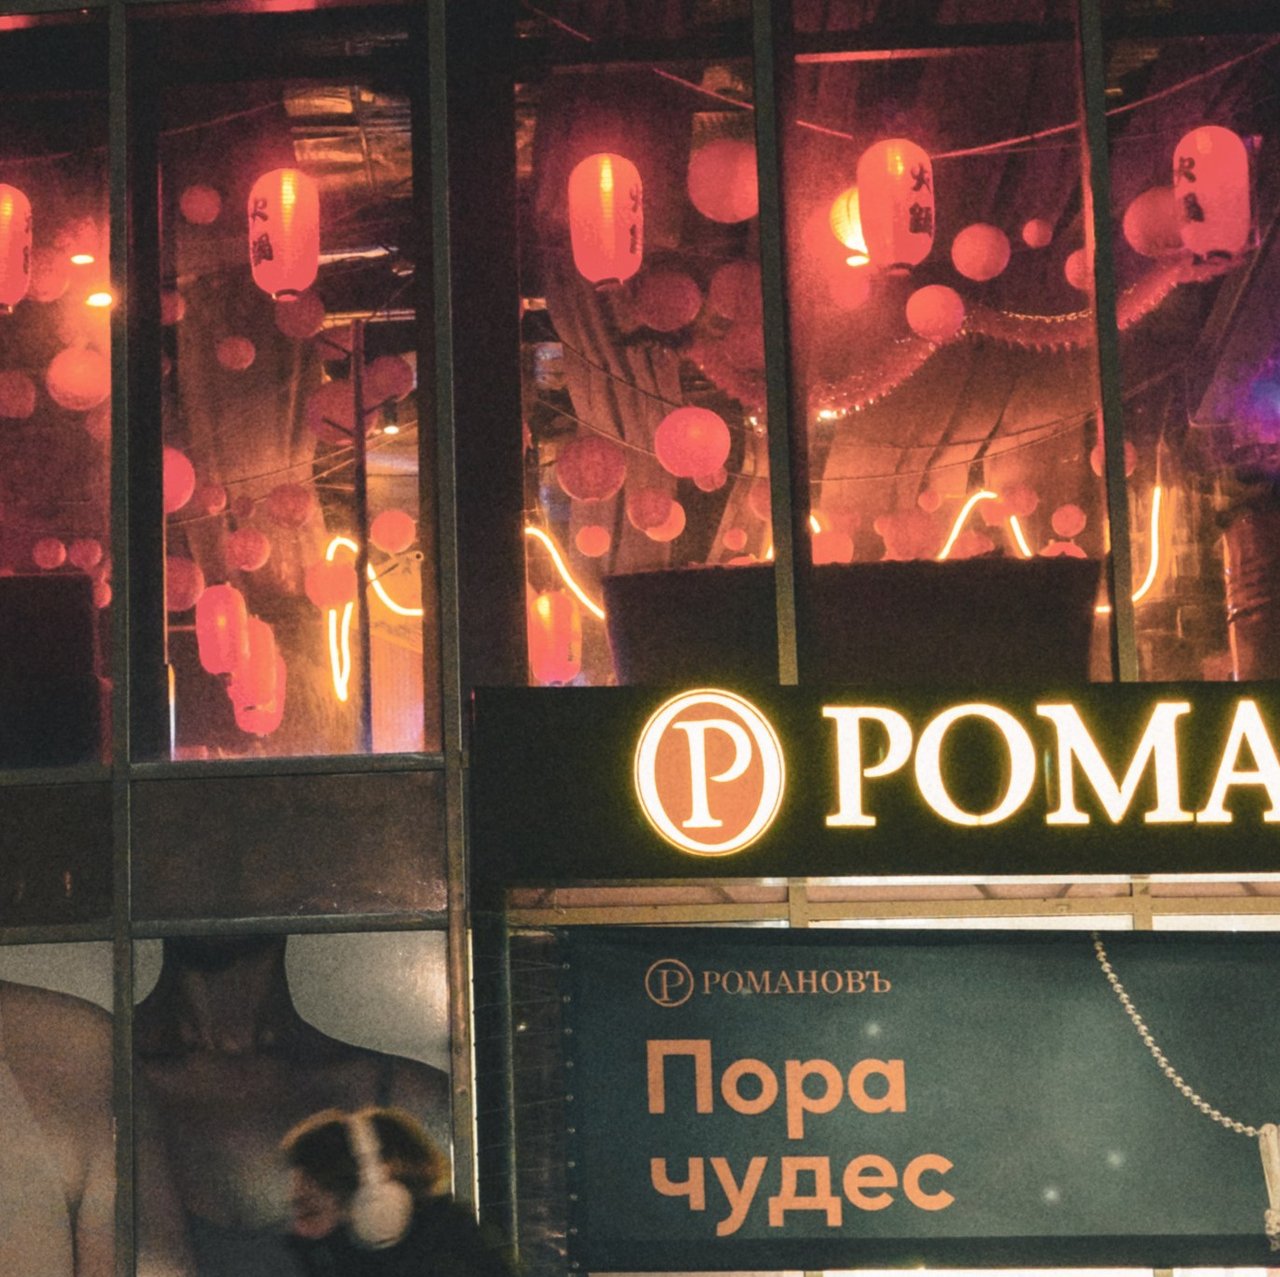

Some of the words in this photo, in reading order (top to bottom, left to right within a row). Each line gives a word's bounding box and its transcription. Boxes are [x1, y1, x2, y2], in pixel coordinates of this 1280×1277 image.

[822, 699, 1280, 827] РОМА
[701, 969, 892, 995] РОМАНОВЪ
[646, 1038, 907, 1140] Пора
[649, 1153, 956, 1237] чудес
